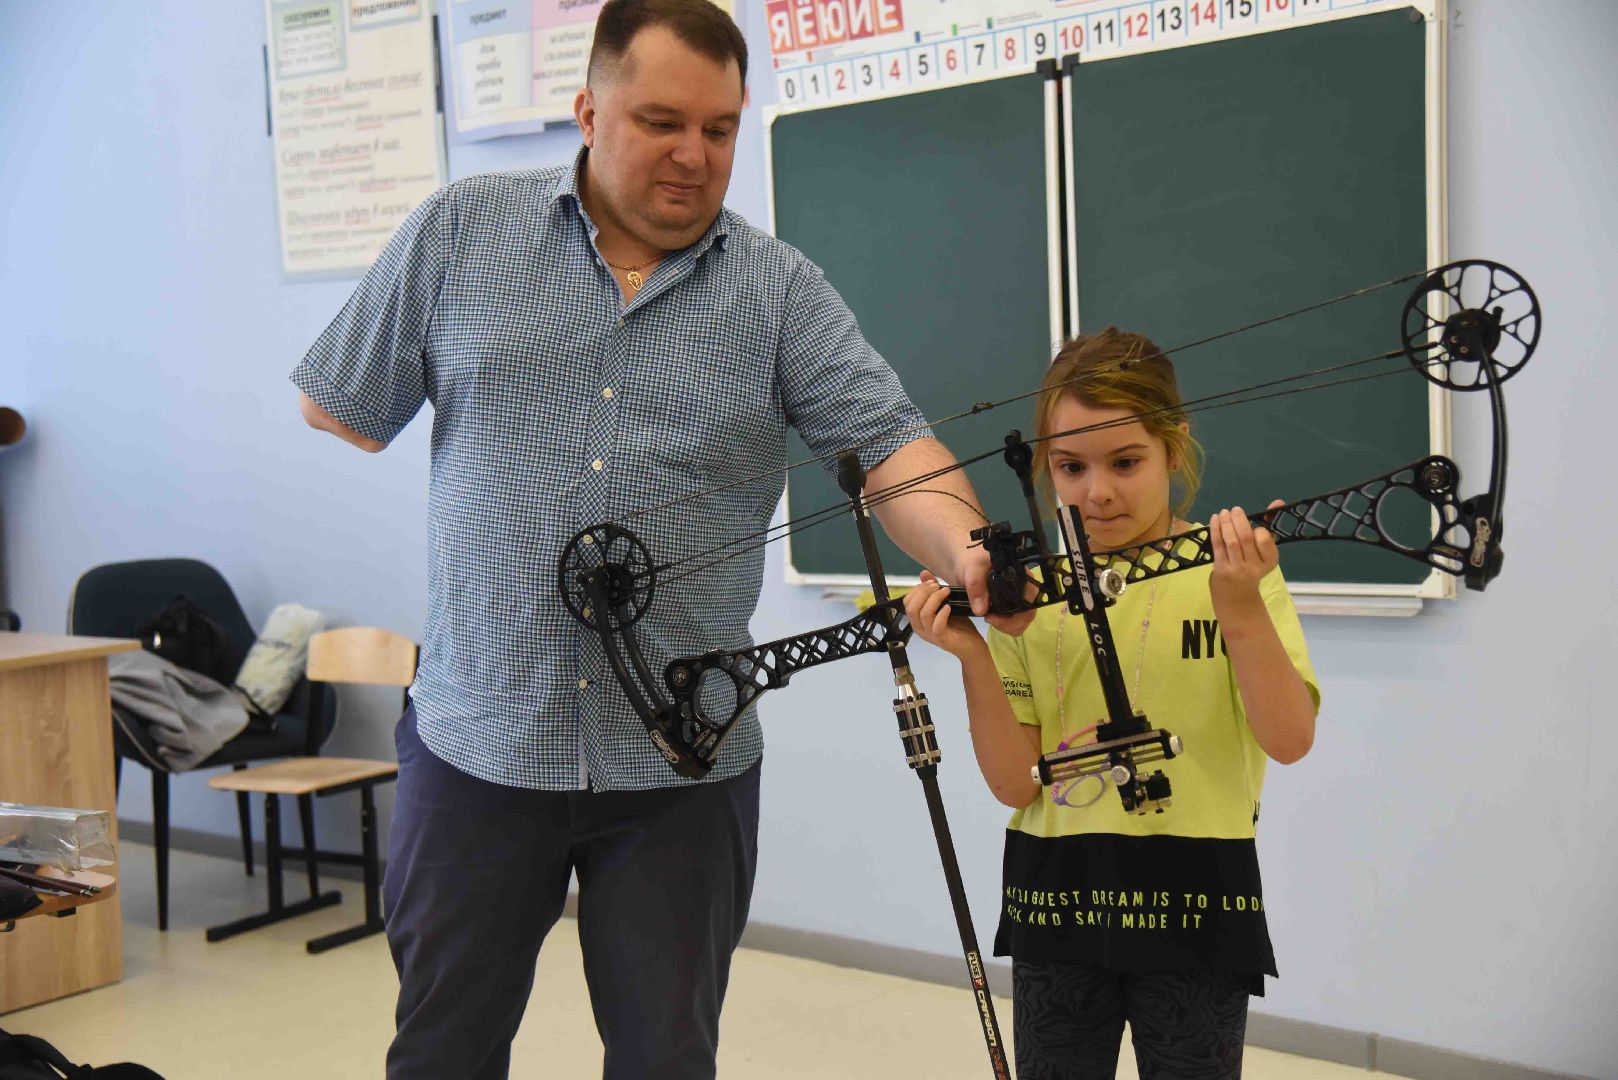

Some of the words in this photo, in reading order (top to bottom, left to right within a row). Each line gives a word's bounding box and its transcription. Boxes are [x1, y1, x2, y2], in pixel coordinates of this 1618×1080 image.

[785, 78, 795, 98] 0
[811, 74, 819, 94] 1
[835, 69, 846, 90] 2
[862, 64, 873, 85] 3
[889, 59, 900, 80] 4
[918, 54, 929, 76] 5
[946, 49, 957, 70] 6
[974, 43, 985, 66] 7
[1004, 37, 1016, 60] 8
[1035, 32, 1046, 55] 9
[1060, 25, 1083, 50] 10
[1093, 19, 1114, 44] 11
[1124, 13, 1148, 38] 12
[1157, 6, 1182, 33] 13
[1190, 0, 1216, 26] 14
[1225, 0, 1252, 19] 15
[1072, 550, 1090, 593] SURE
[1090, 622, 1107, 657] LOC
[1182, 619, 1228, 659] NY
[1028, 911, 1062, 926] AND
[1075, 910, 1102, 926] SAY
[1122, 913, 1167, 929] MADE
[1183, 914, 1202, 929] IT
[1092, 890, 1143, 907] DREAM
[1153, 891, 1170, 907] IS
[1184, 893, 1208, 909] TO
